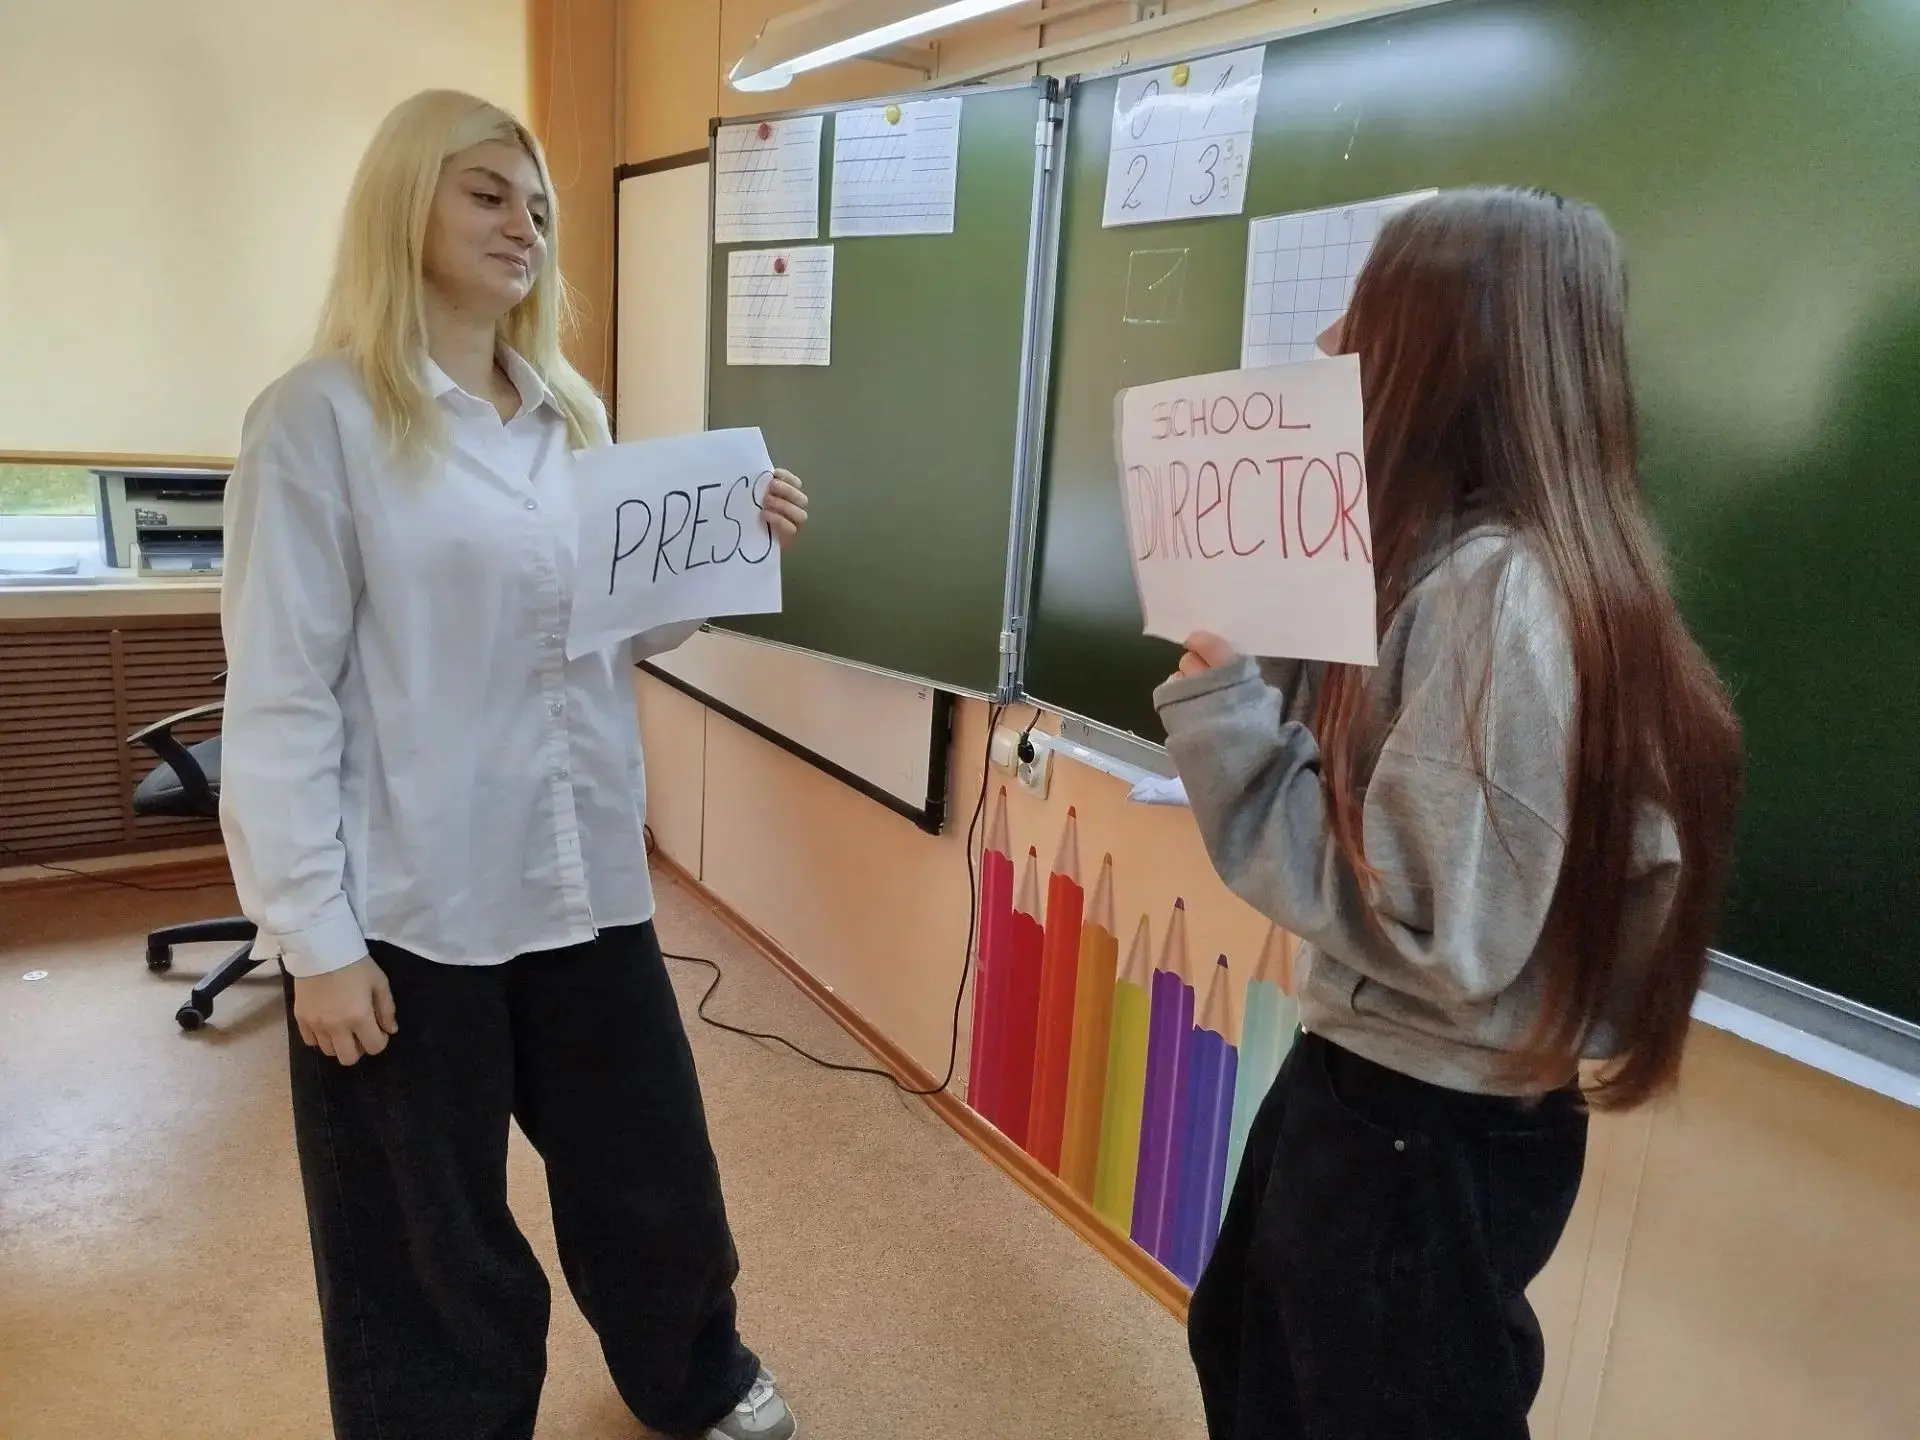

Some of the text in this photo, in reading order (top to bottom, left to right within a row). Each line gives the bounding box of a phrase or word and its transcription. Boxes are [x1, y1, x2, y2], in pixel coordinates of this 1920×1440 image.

[1131, 63, 1234, 140] 0 1
[1121, 143, 1220, 210] 2 3
[1151, 391, 1312, 440] SCHOOL
[608, 469, 776, 596] PRESS
